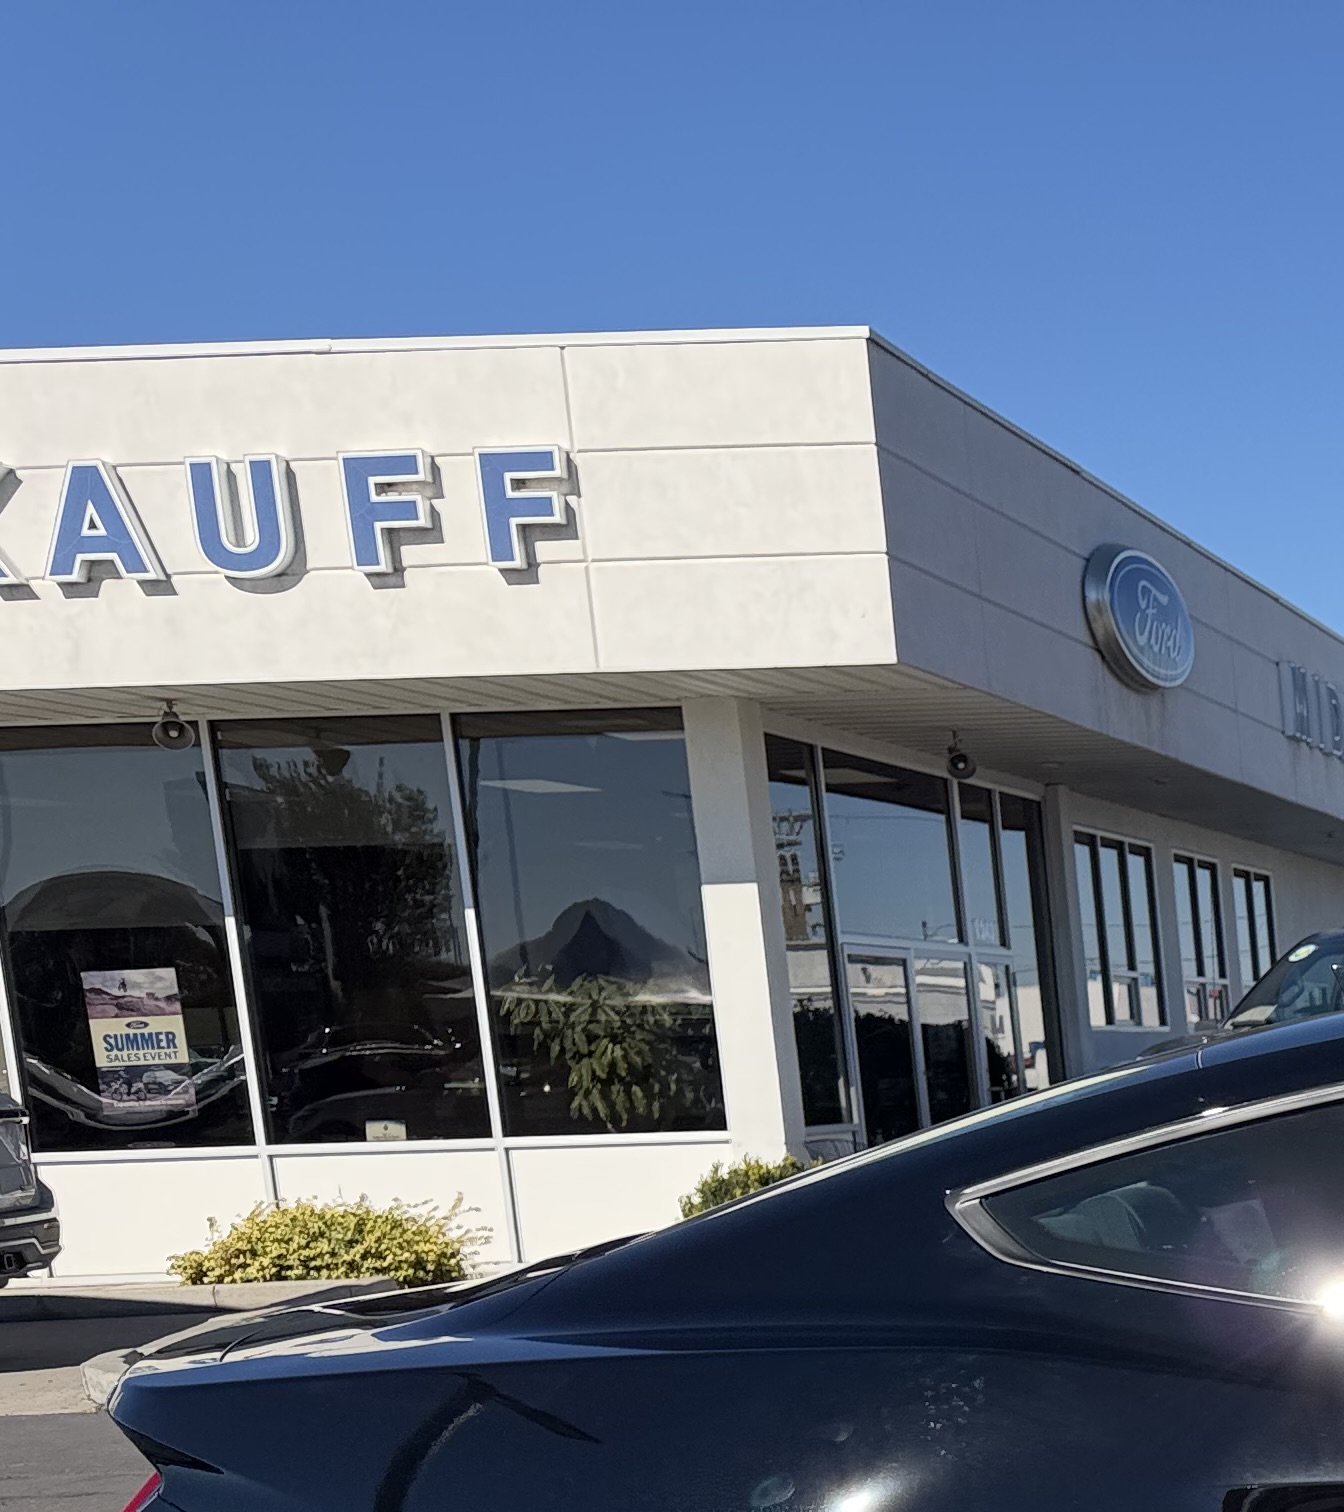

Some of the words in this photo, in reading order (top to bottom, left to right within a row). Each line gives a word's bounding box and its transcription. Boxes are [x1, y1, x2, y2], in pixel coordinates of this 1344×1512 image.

[0, 445, 570, 585] AUFF
[1135, 579, 1184, 661] Ford
[103, 1032, 178, 1053] SUMMER
[106, 1052, 141, 1063] SALES
[144, 1051, 180, 1062] EVENT
